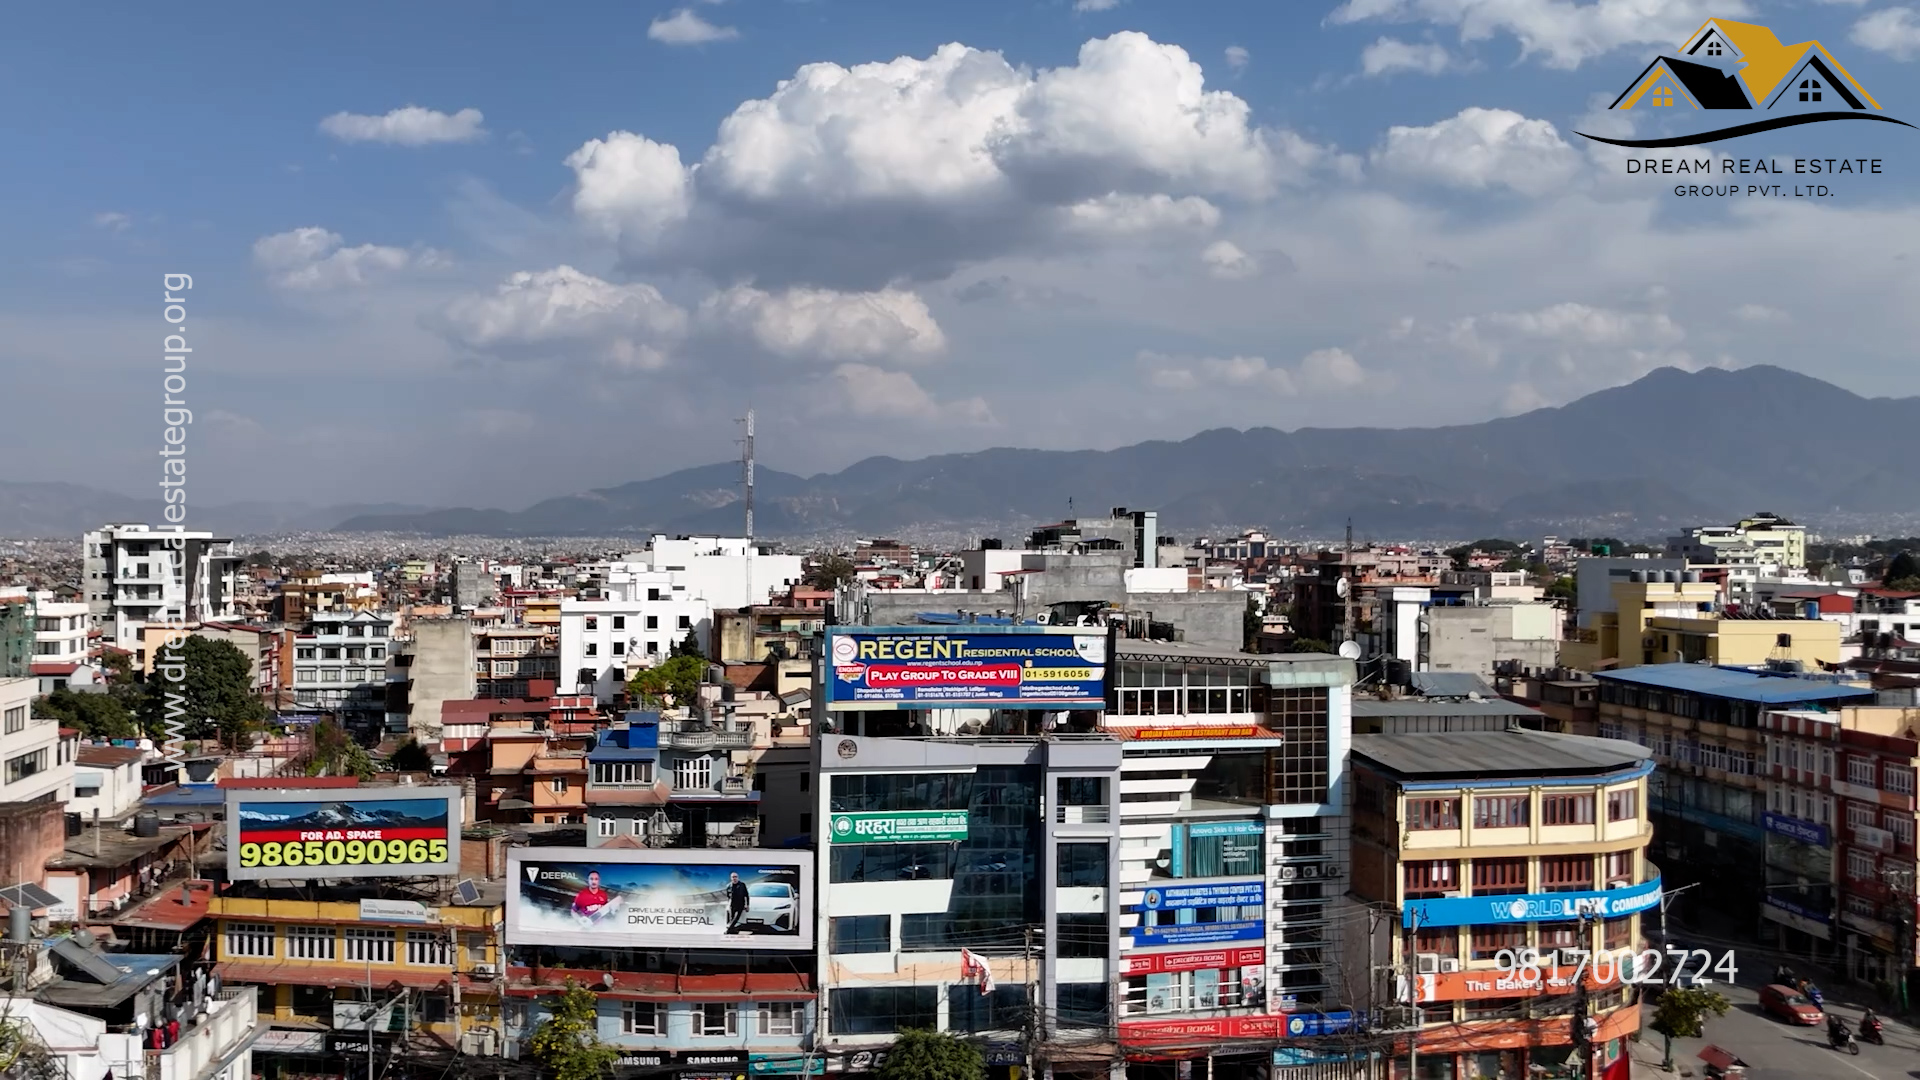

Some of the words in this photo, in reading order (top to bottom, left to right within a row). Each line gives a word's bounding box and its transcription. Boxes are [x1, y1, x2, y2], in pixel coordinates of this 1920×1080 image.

[860, 640, 968, 660] REGENT
[963, 648, 1034, 657] RESIDENTIAL
[1035, 648, 1079, 657] SCHOOL
[1025, 670, 1090, 678] 01-5916056
[301, 831, 323, 841] FOR
[325, 831, 344, 840] AD.
[347, 830, 382, 840] SPACE
[240, 838, 448, 867] 9865090965
[541, 871, 578, 880] DEEPAL
[628, 915, 664, 925] DRIVE
[666, 916, 714, 926] DEEPAL
[1465, 980, 1490, 991] The
